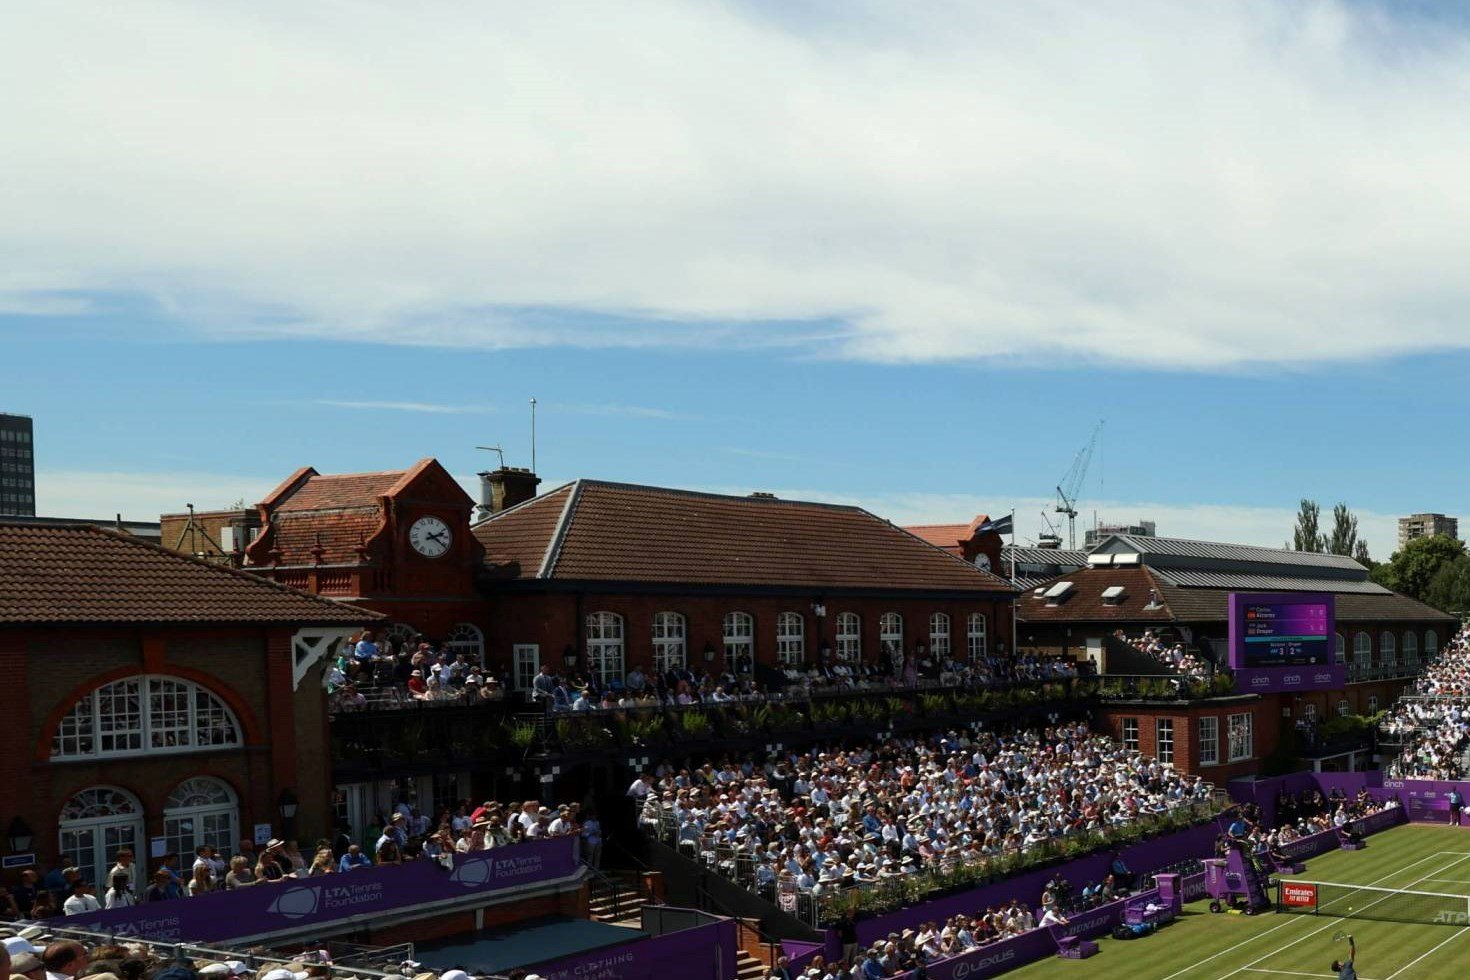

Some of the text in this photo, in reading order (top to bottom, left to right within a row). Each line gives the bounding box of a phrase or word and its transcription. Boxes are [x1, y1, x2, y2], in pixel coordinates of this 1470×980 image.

[1384, 779, 1404, 788] cinch
[324, 887, 351, 899] LTA
[1285, 887, 1314, 897] Emirates
[324, 892, 385, 909] Foundation
[1433, 910, 1468, 924] ATP
[1069, 914, 1111, 935] DUNLOP
[970, 949, 1016, 972] LEXUS
